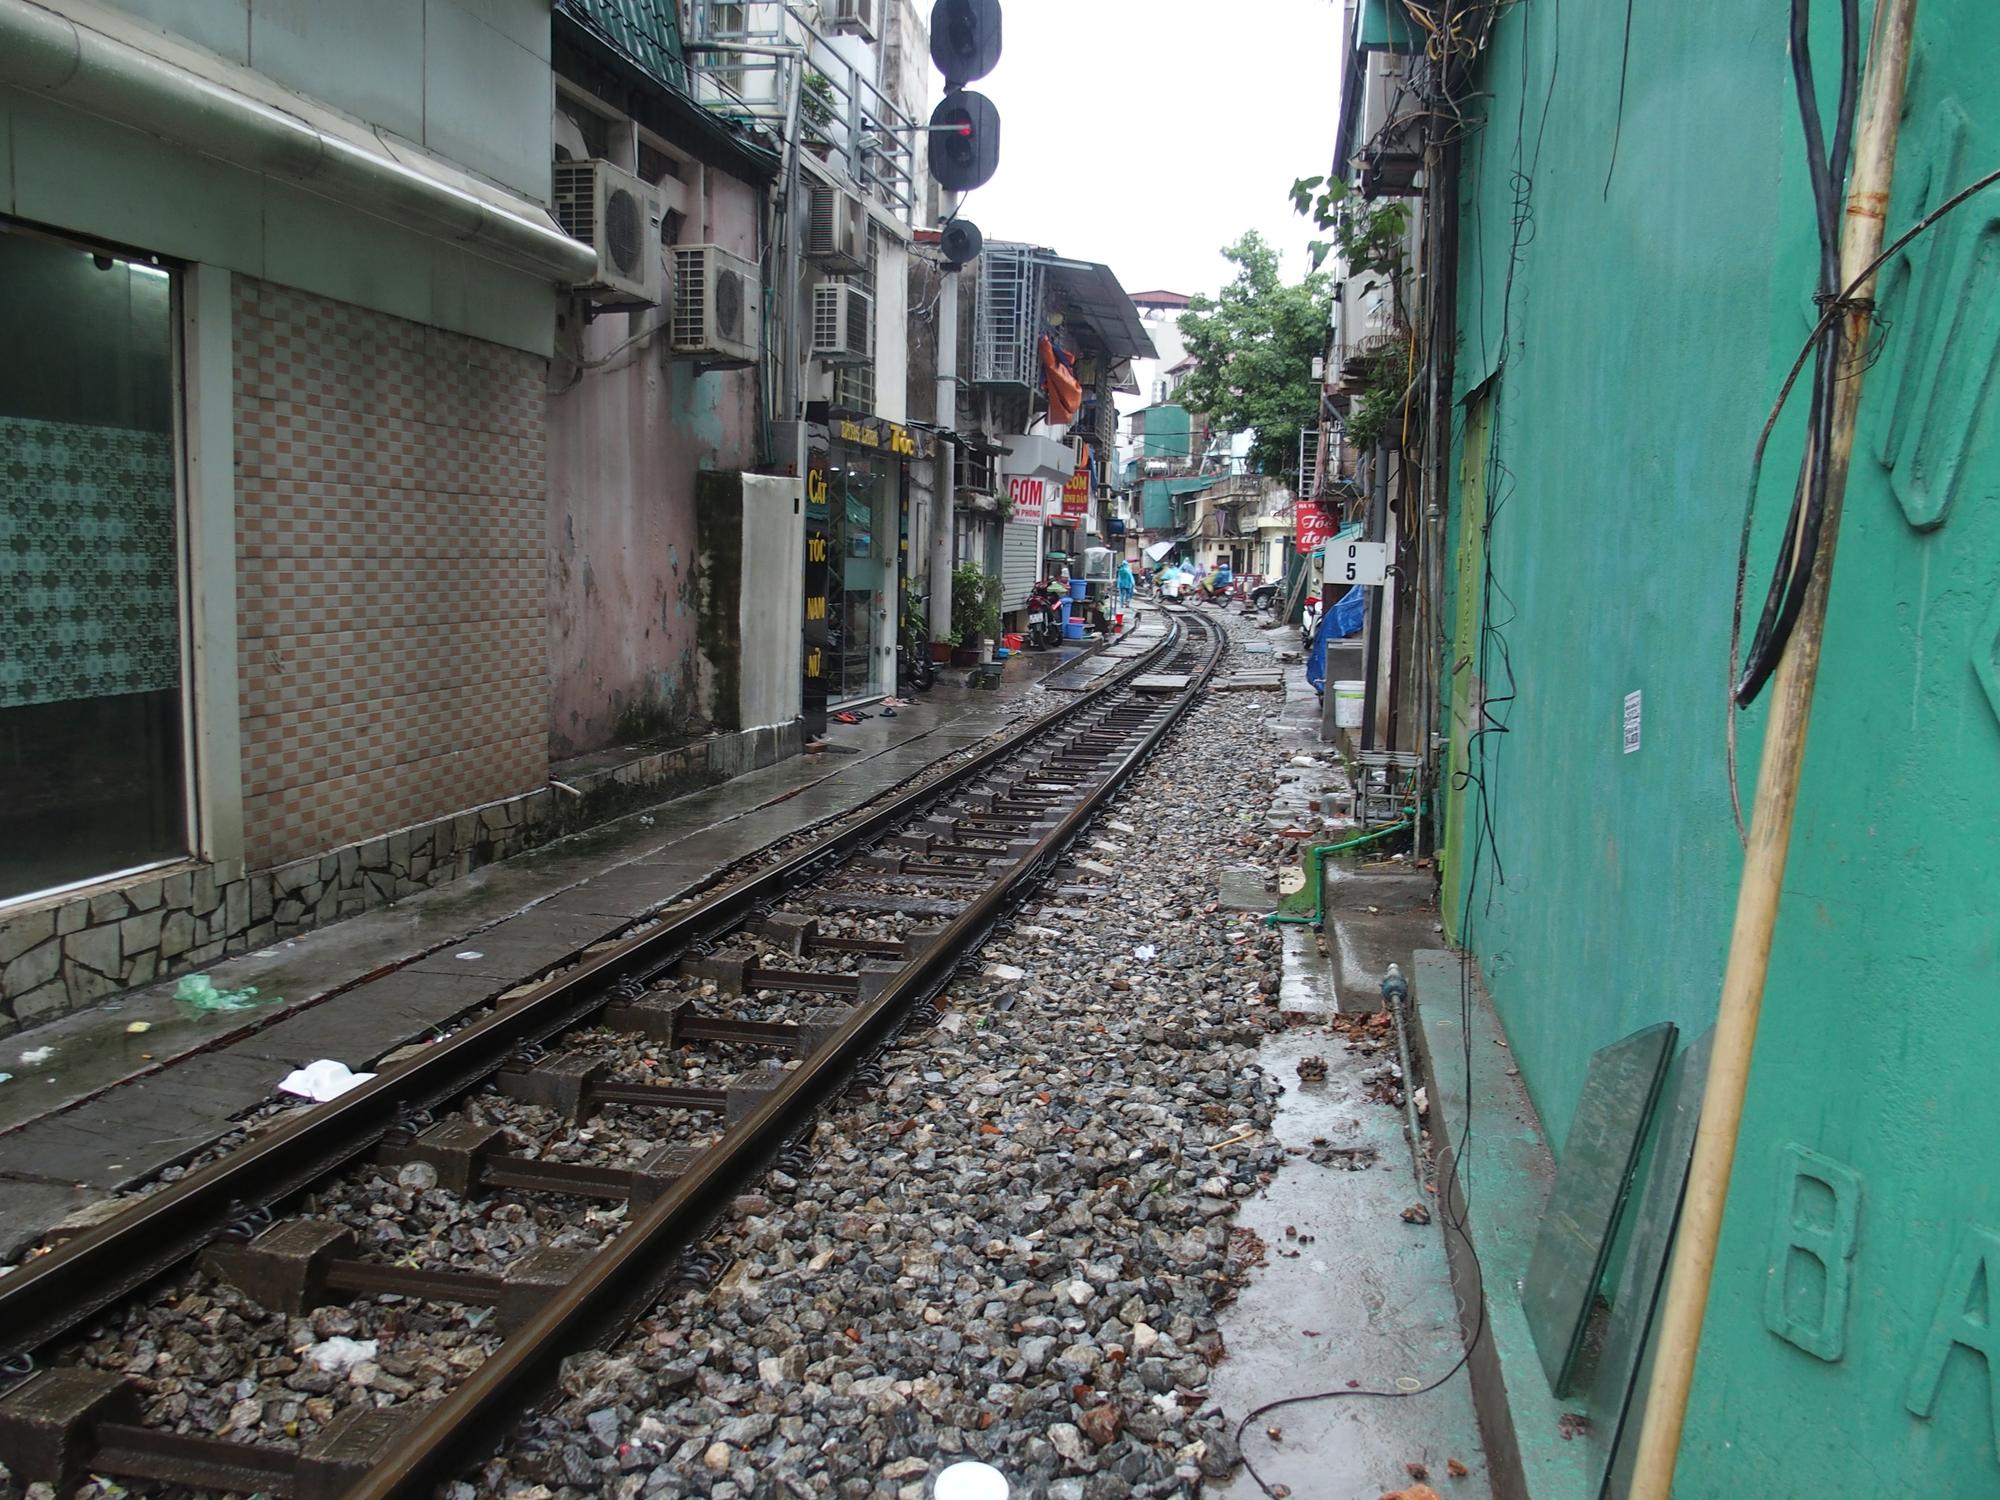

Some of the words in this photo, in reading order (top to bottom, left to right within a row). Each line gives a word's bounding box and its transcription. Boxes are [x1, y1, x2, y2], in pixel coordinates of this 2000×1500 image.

[1010, 477, 1043, 506] CƠM
[808, 531, 826, 562] TÓC
[1348, 545, 1356, 558] 0
[1346, 562, 1356, 581] 5
[807, 596, 825, 620] NAM
